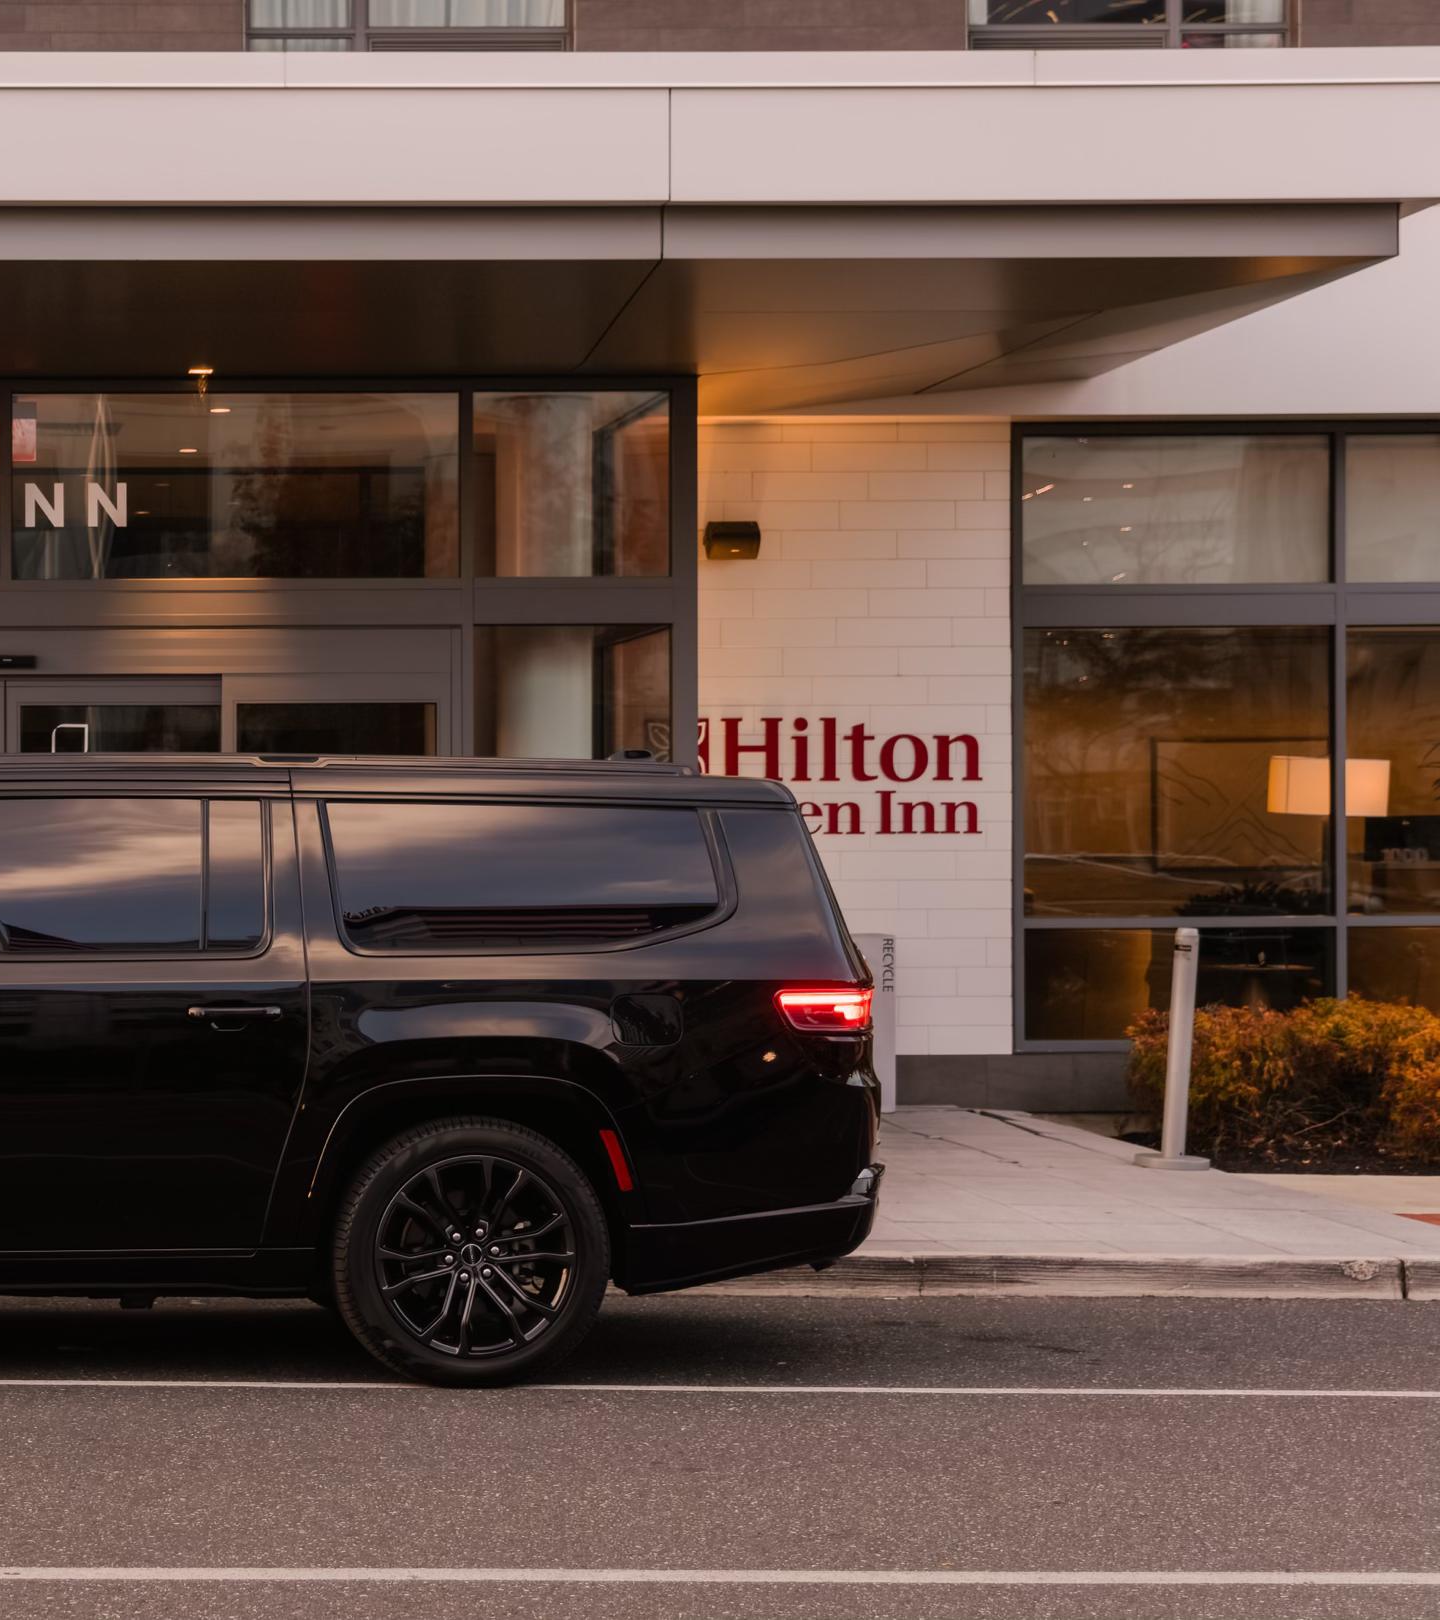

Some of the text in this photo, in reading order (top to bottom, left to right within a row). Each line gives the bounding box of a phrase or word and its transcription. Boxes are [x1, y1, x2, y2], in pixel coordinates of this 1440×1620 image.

[721, 717, 983, 782] Hilton
[875, 790, 983, 834] Inn
[882, 938, 895, 993] RECYCLE
